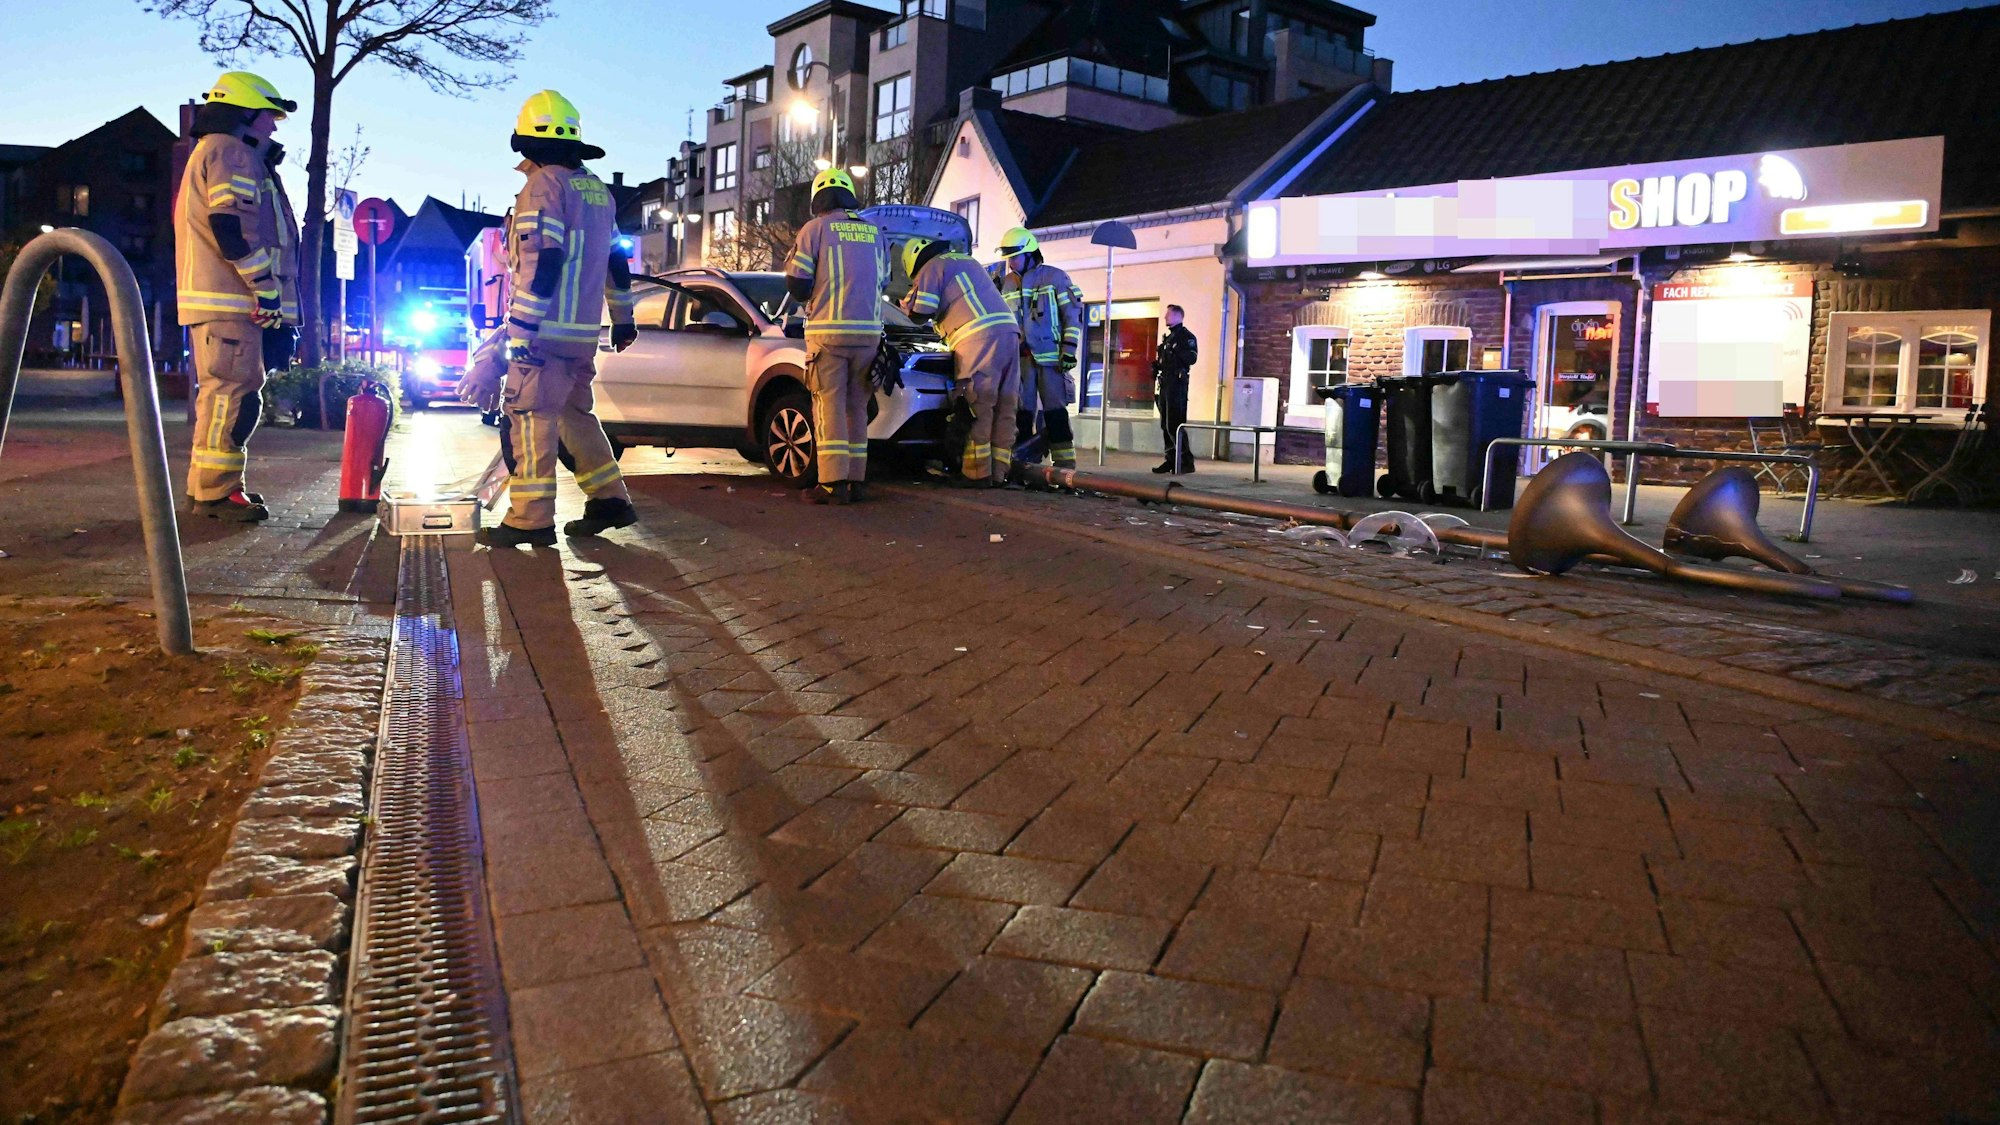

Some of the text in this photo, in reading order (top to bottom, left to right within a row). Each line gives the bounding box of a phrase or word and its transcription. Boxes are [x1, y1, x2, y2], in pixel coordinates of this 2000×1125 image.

[1609, 170, 1747, 230] SHOP
[830, 222, 879, 235] FEUERWEHR
[839, 232, 875, 244] PULHEIM
[1436, 260, 1450, 270] LG
[1663, 287, 1688, 298] FACH
